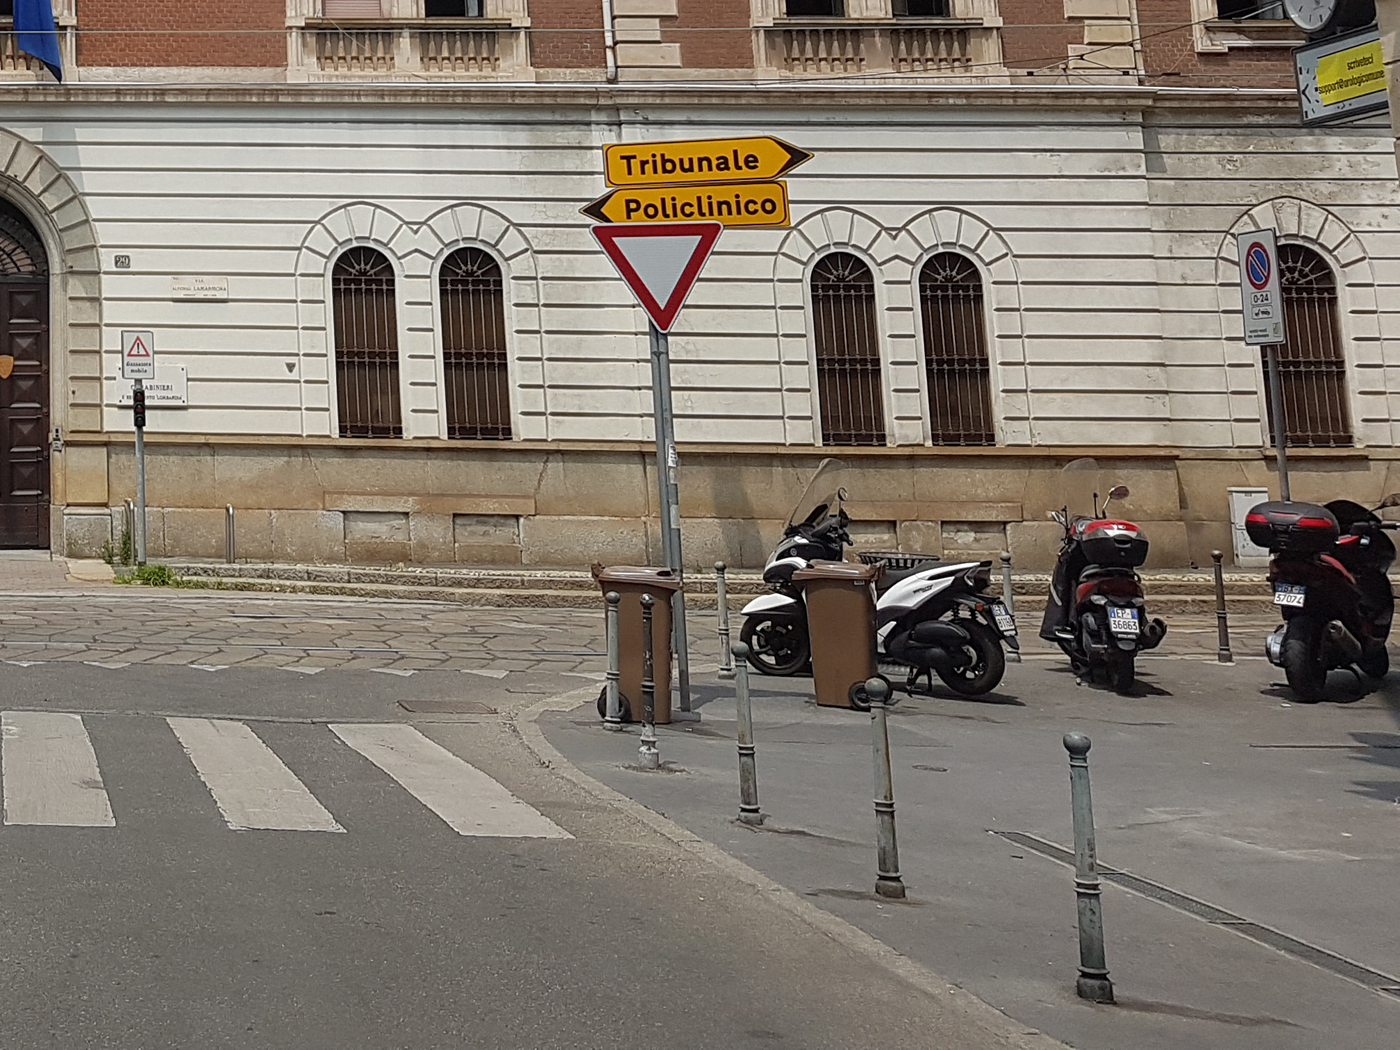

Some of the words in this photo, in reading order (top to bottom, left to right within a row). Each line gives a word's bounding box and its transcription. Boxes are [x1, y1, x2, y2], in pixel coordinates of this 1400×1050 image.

[619, 149, 760, 176] Tribunale
[624, 193, 777, 220] Policlinico
[116, 256, 130, 268] 29
[1253, 293, 1269, 304] 0-24
[1116, 608, 1126, 618] EP
[1112, 619, 1138, 631] 36863
